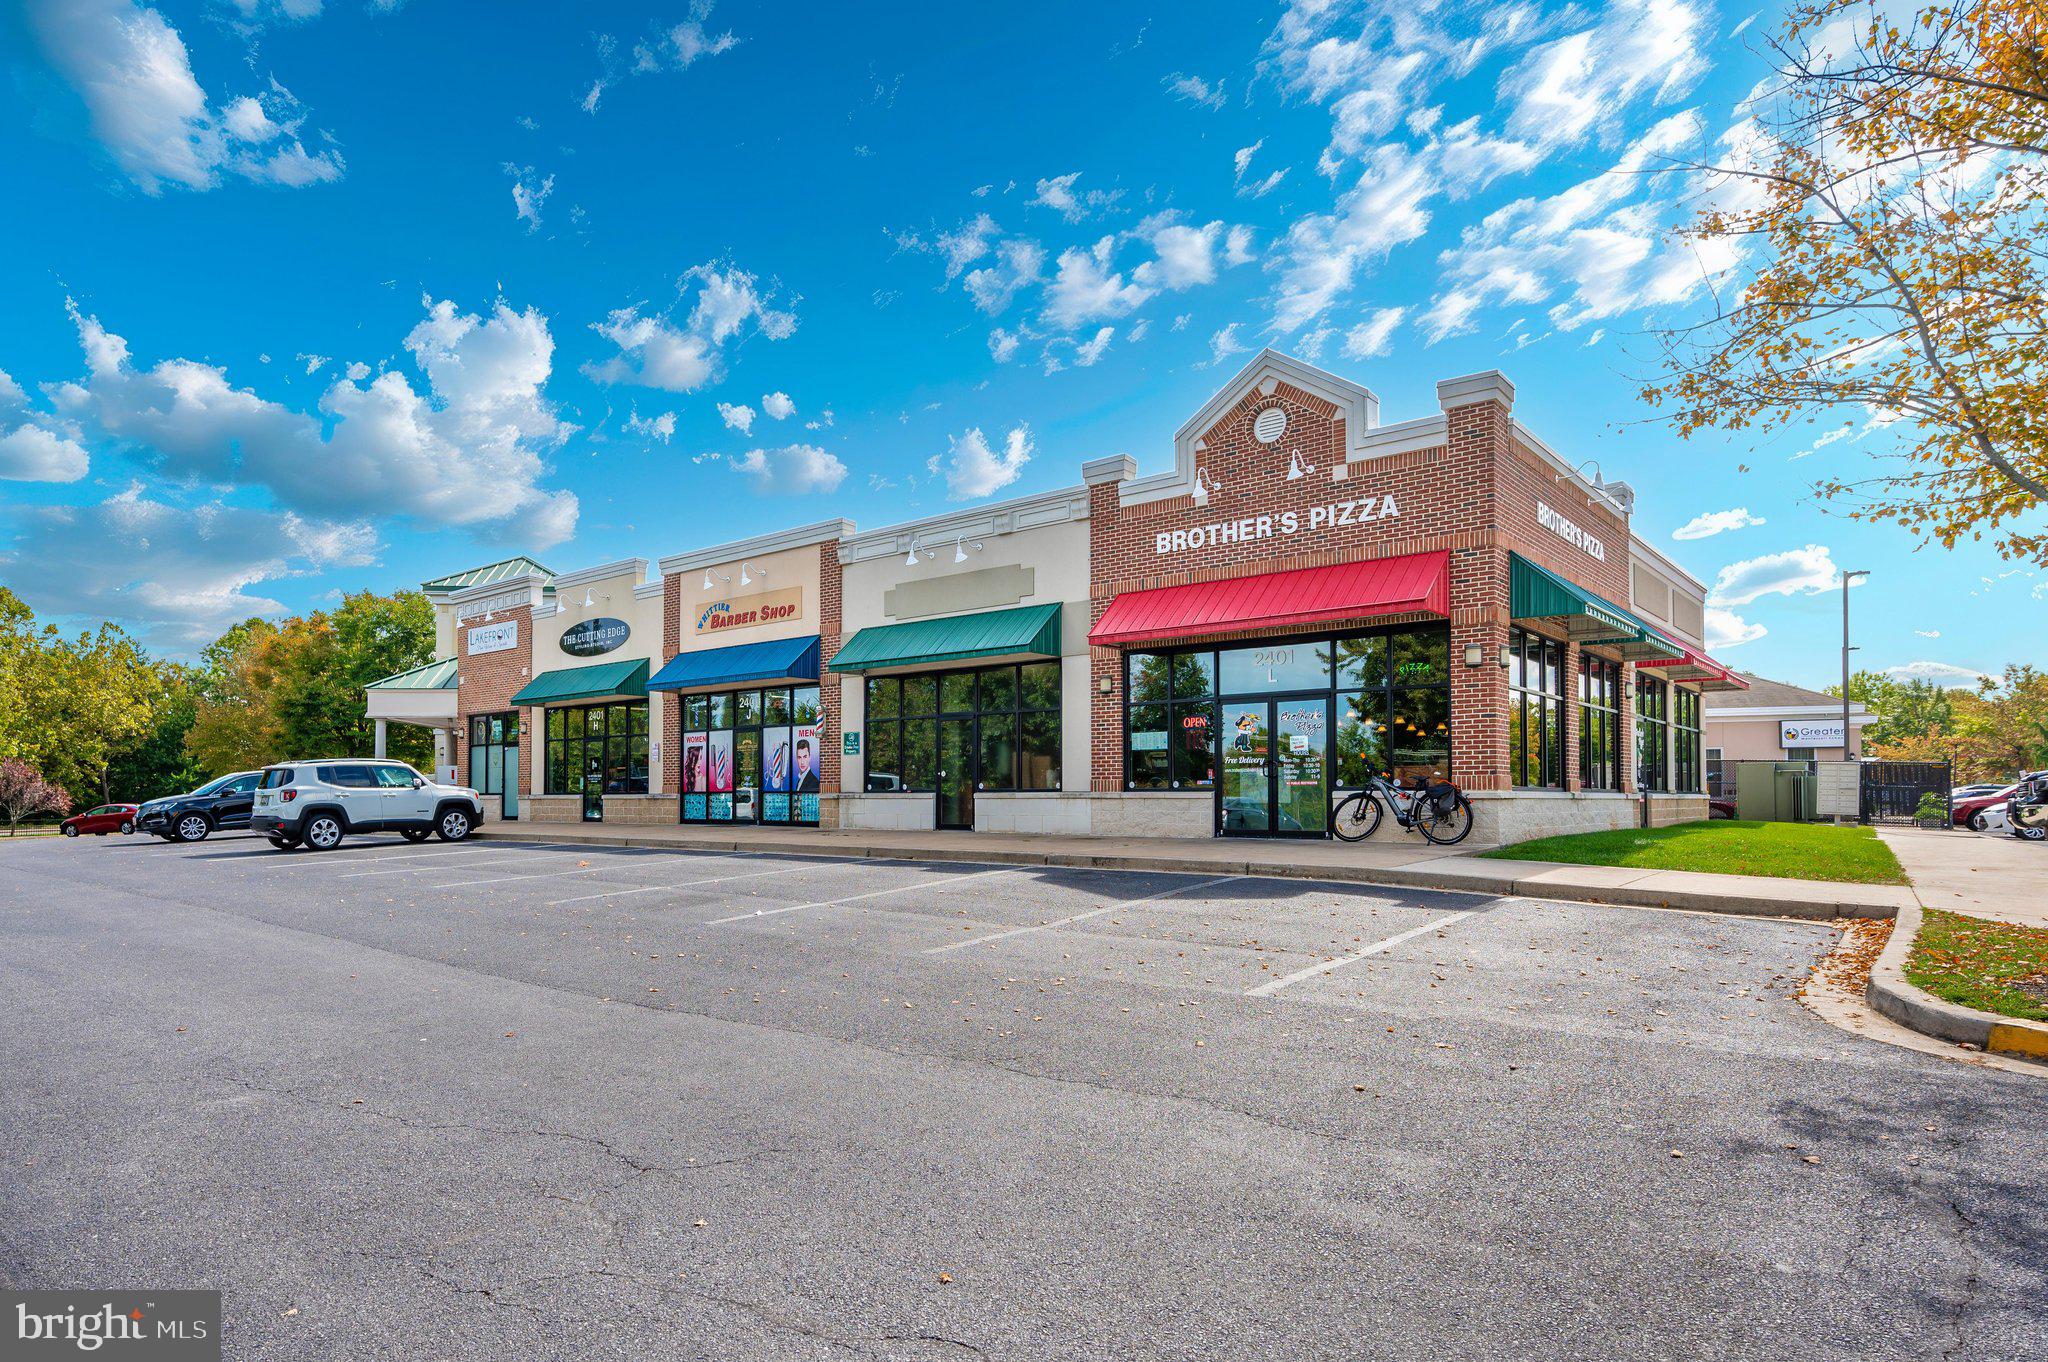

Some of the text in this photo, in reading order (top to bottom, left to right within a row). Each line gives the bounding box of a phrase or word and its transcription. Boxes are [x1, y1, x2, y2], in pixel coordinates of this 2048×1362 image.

[1156, 495, 1399, 554] BROTHER'S PIZZA
[1536, 500, 1605, 562] BROTHER'S PIZZA
[697, 602, 730, 630] WHITTIER
[710, 604, 796, 629] BARBER SHOP
[469, 626, 514, 646] LAKEFRONT
[563, 626, 626, 646] THE CUTTING EDGE
[1254, 649, 1295, 666] 2401
[1399, 662, 1430, 674] PIZZA
[1267, 668, 1278, 683] L
[588, 710, 604, 721] 2401
[746, 708, 752, 720] J
[1280, 708, 1324, 722] Brother's
[593, 721, 599, 731] H
[1183, 716, 1206, 728] OPEN
[798, 729, 815, 738] MEN
[1800, 727, 1845, 736] Greater
[686, 735, 707, 744] WOMEN
[1224, 756, 1265, 766] Free Delivery
